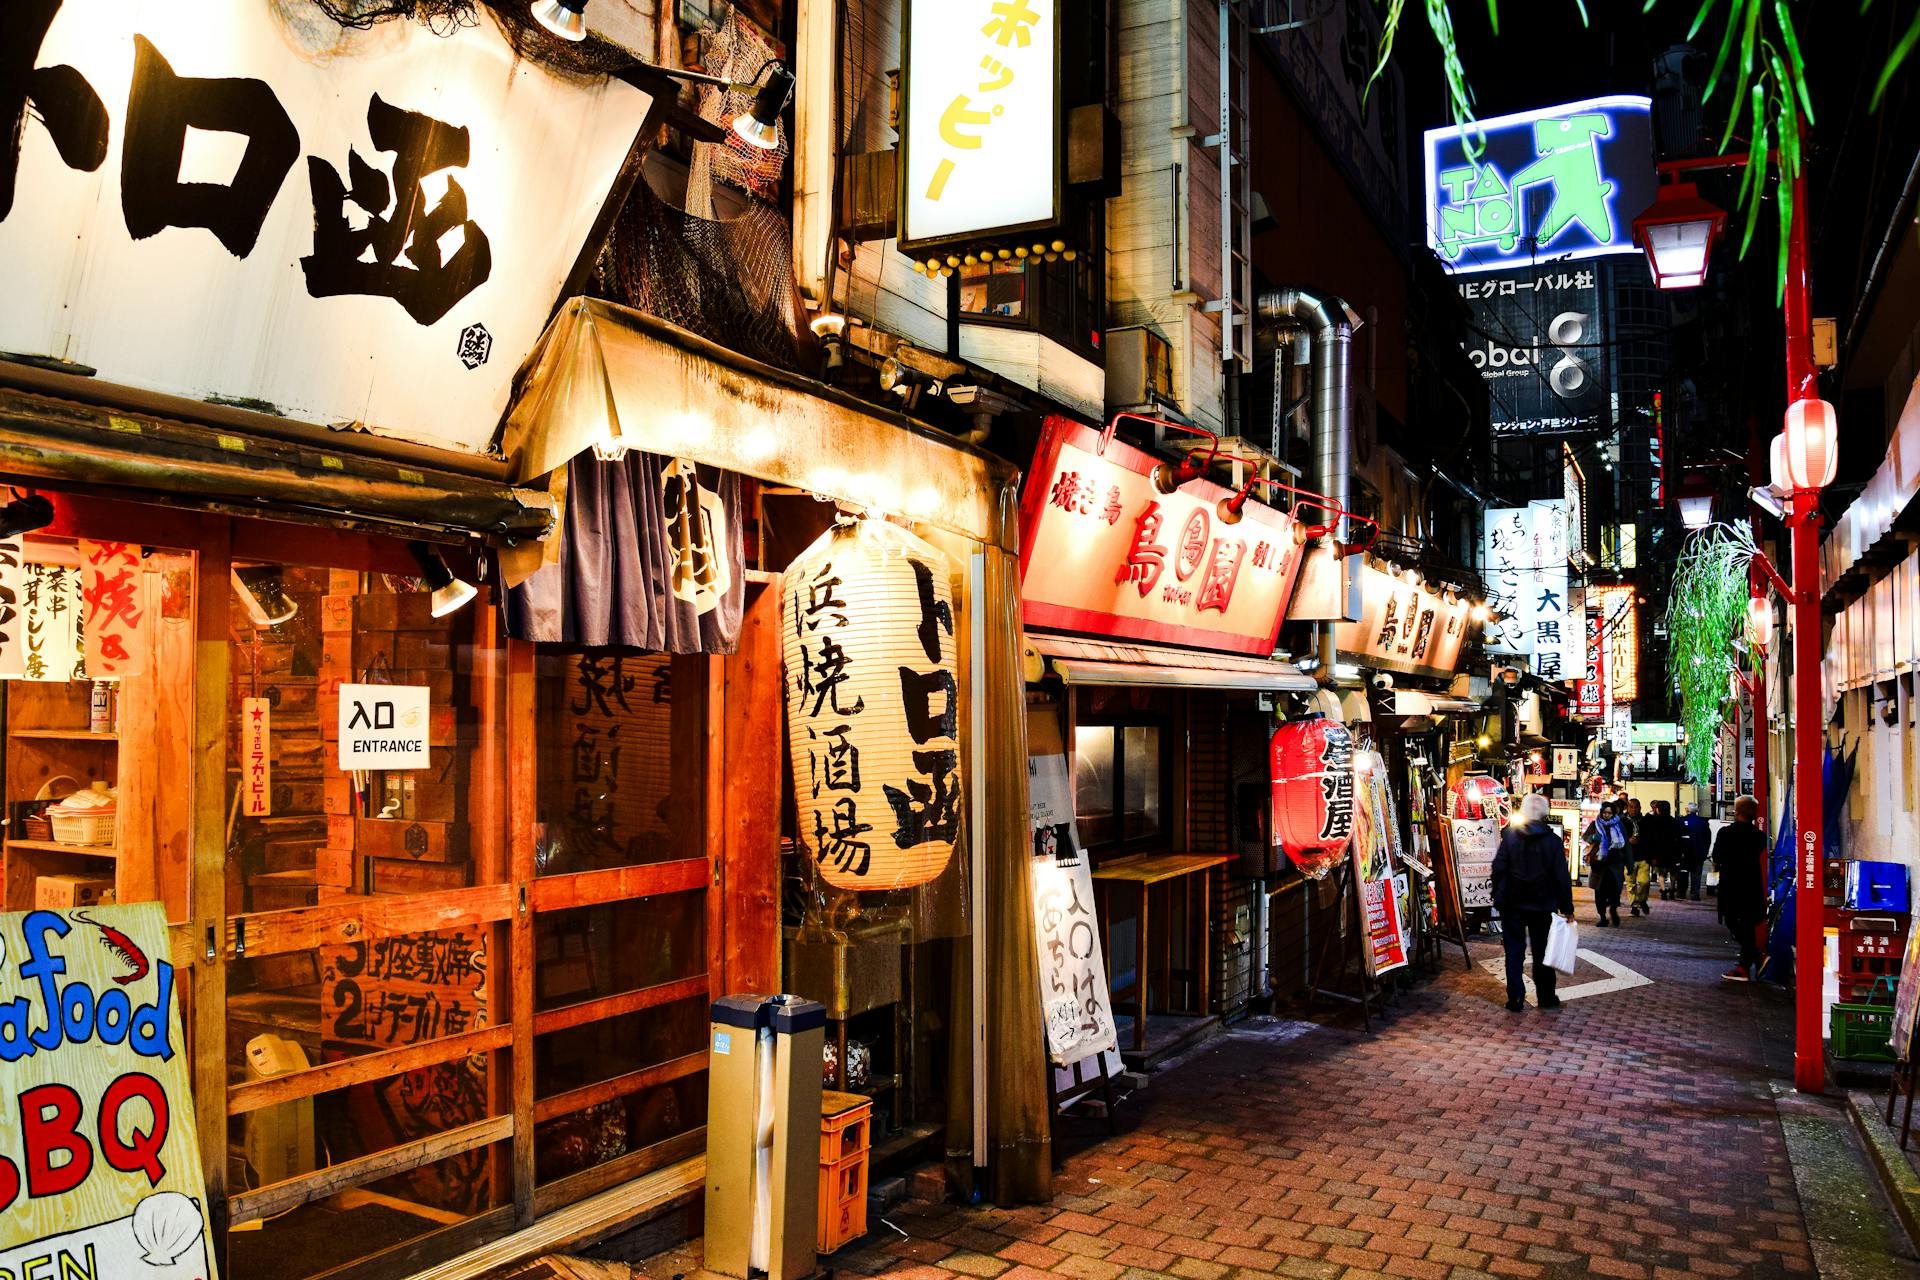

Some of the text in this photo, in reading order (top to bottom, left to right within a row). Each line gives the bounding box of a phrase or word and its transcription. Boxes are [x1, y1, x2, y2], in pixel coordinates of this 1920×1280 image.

[925, 0, 1041, 201] ホッピー
[1460, 335, 1538, 369] obal
[1536, 588, 1561, 680] 大黒屋
[348, 701, 394, 729] 入口
[353, 739, 422, 753] ENTRANCE
[795, 562, 873, 877] 浜焼酒場
[252, 723, 265, 813] サッポロラガービール
